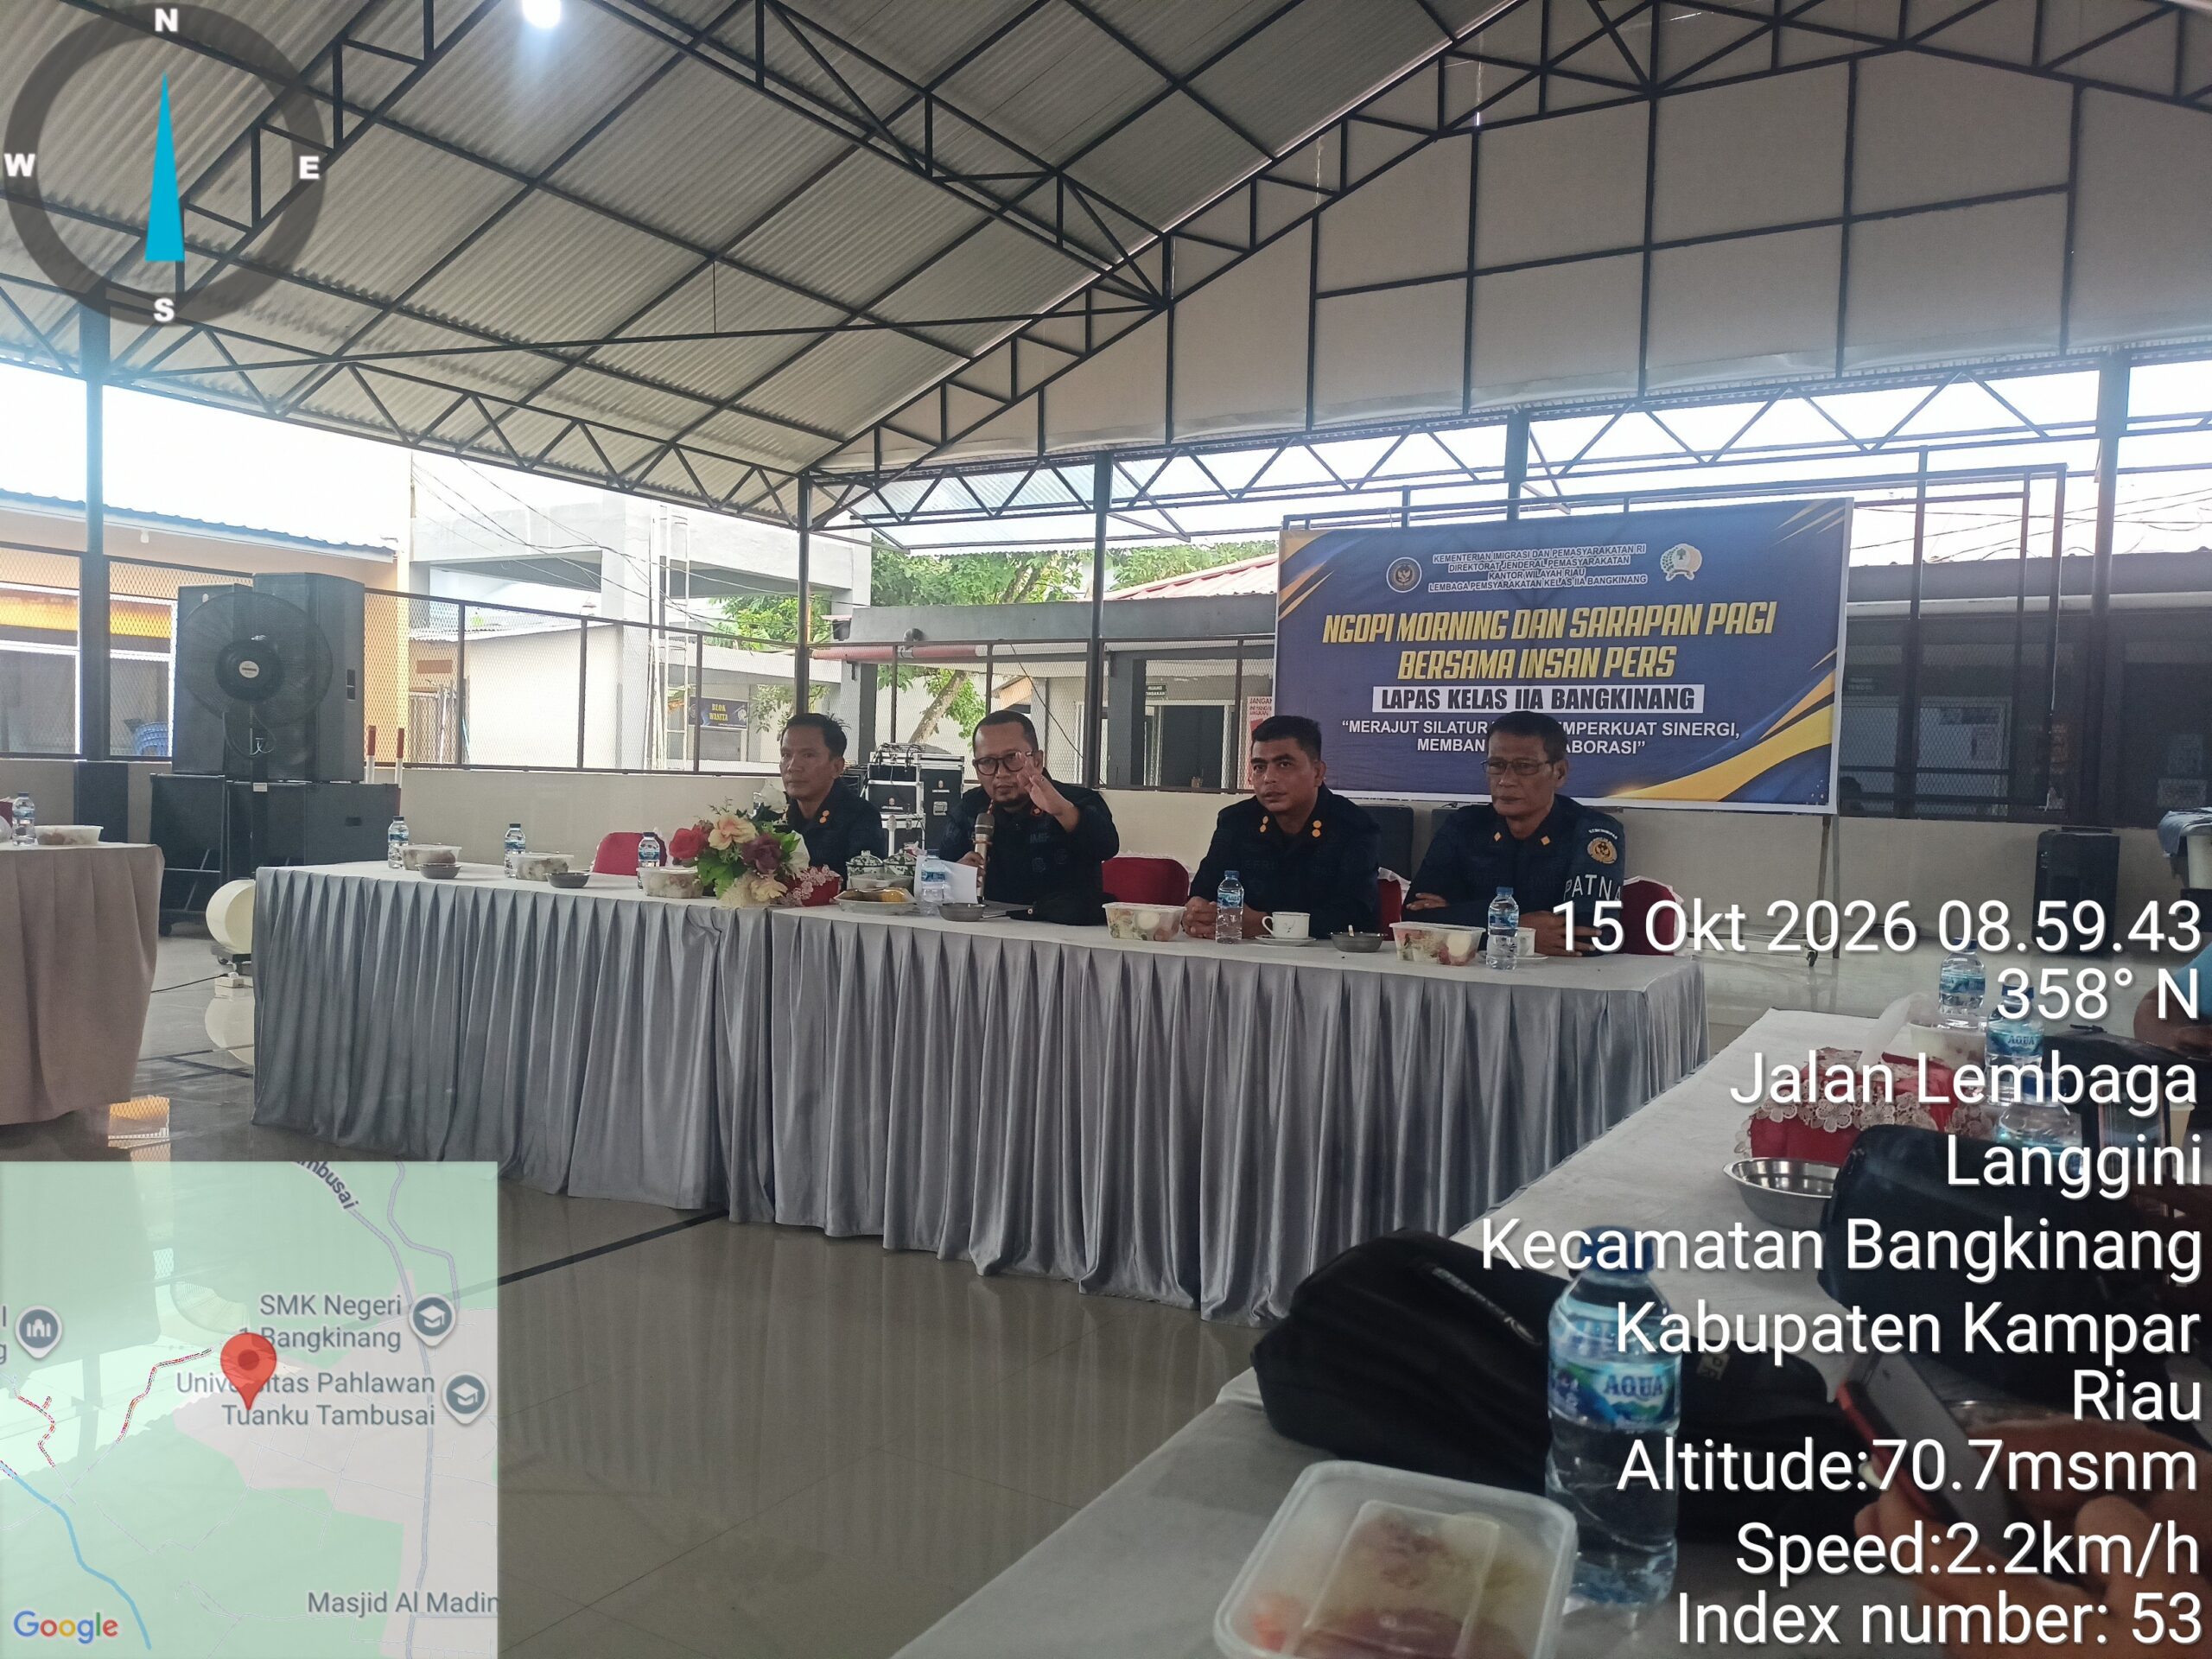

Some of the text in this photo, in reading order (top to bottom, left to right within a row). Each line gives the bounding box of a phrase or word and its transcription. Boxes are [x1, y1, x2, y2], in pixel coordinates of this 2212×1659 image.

[1433, 544, 1646, 563] KEMENTERIAN IMIGRASI DAN PEMASYARAKATAN RI
[1449, 556, 1630, 572] DIREKTORAT JENDERAL PEMASYARAKATAN
[1429, 582, 1469, 592] LEMBAGA
[1543, 578, 1573, 587] KELAS
[1574, 577, 1586, 586] IIA
[1587, 575, 1647, 585] BANGKINANG
[1489, 569, 1586, 580] KANTOR WILAYAH RIAU
[1322, 601, 1777, 643] NGOPI MORNING DAN SARAPAN PAGI
[1397, 645, 1677, 680] BERSAMA INSAN PERS
[1381, 687, 1695, 710] LAPAS KELAS IIA BANGKINANG
[1423, 720, 1489, 734] SILATUR
[1558, 721, 1657, 736] MPERKUAT
[1662, 721, 1740, 741] SINERGI,
[1417, 738, 1486, 752] MEMBAN
[1604, 1375, 1664, 1400] AQUA
